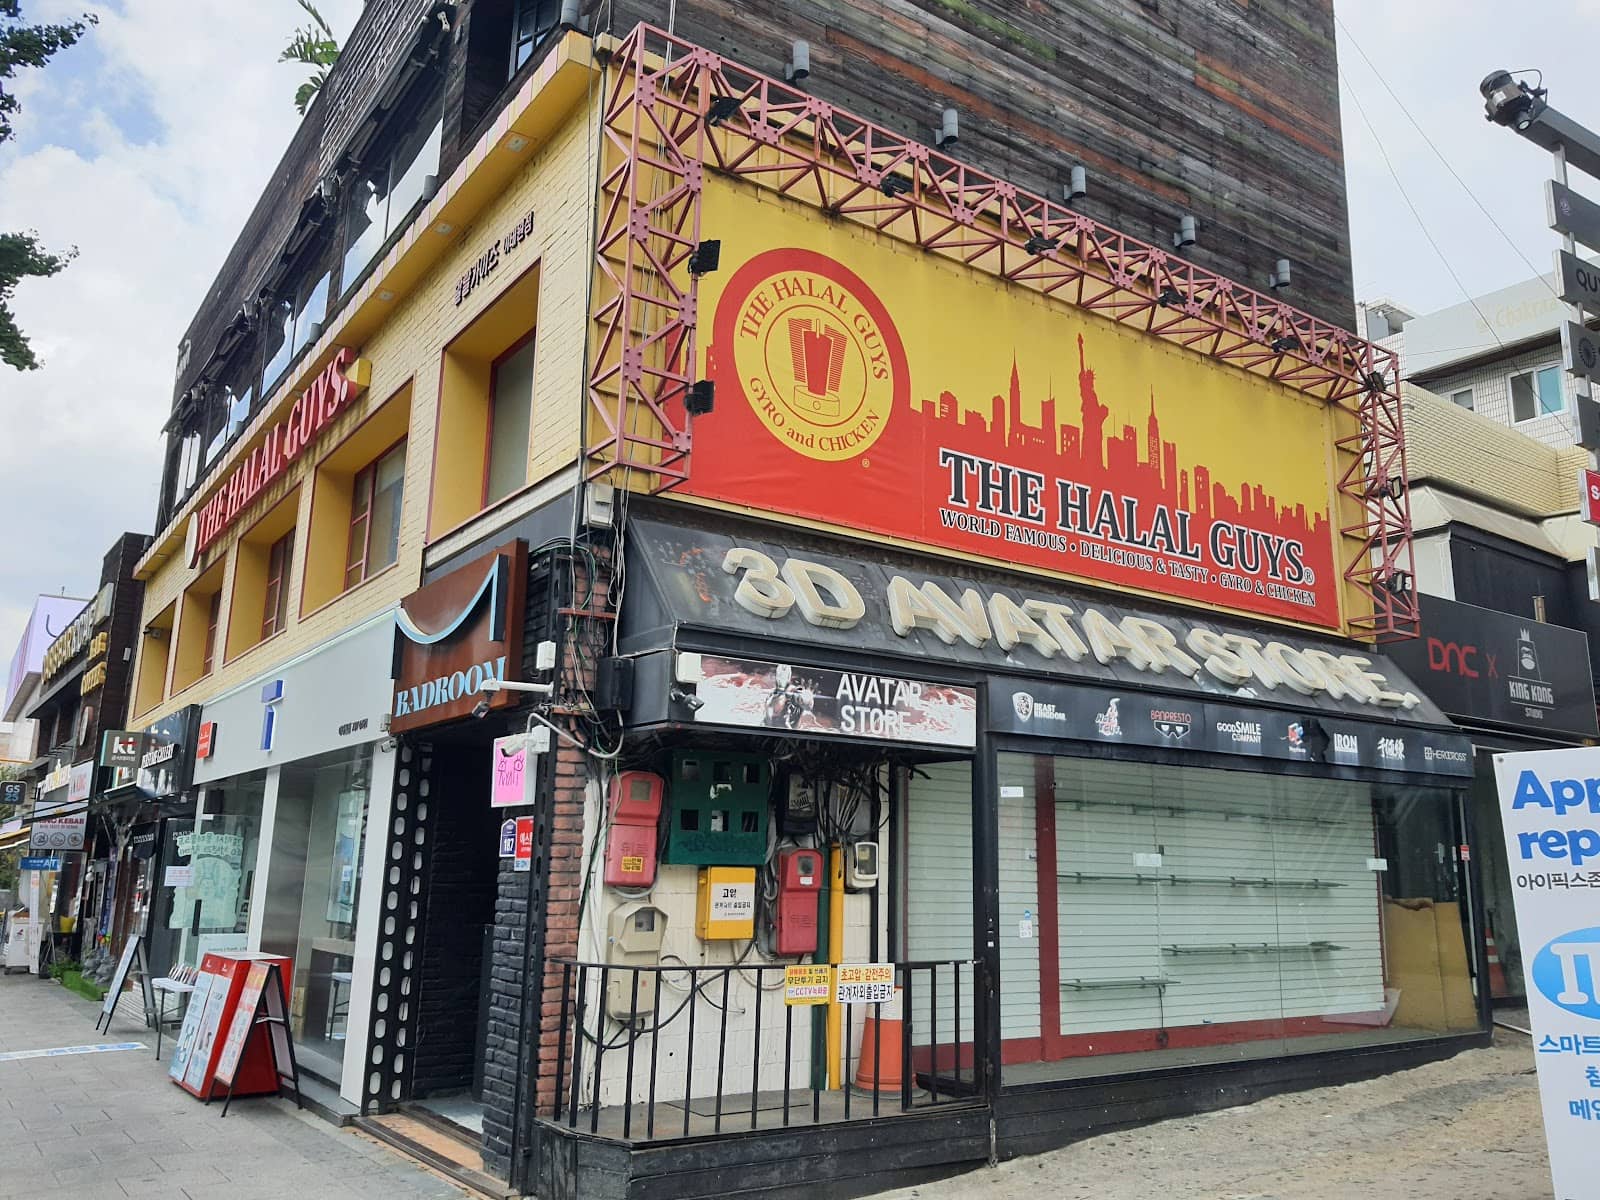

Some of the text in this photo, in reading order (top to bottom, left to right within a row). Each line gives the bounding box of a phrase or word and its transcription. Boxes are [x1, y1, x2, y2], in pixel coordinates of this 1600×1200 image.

[1576, 268, 1600, 292] QU
[740, 276, 889, 382] THE HALAL GUYS
[750, 377, 880, 452] GYRO and CHICKEN
[198, 347, 348, 550] THE HALAL GUYS
[939, 447, 1304, 585] THE HALAL GUYS
[939, 508, 1316, 607] WORLD FAMOUS DELICIOUS & TASTY GYRO & CHICKEN
[721, 547, 1421, 709] 3D AVATAR STORE
[835, 673, 922, 708] AVATAR
[1508, 681, 1554, 704] KING KONG
[841, 704, 912, 739] STORE
[1334, 733, 1358, 751] IRON
[5, 784, 20, 794] GS
[816, 975, 829, 984] 금지
